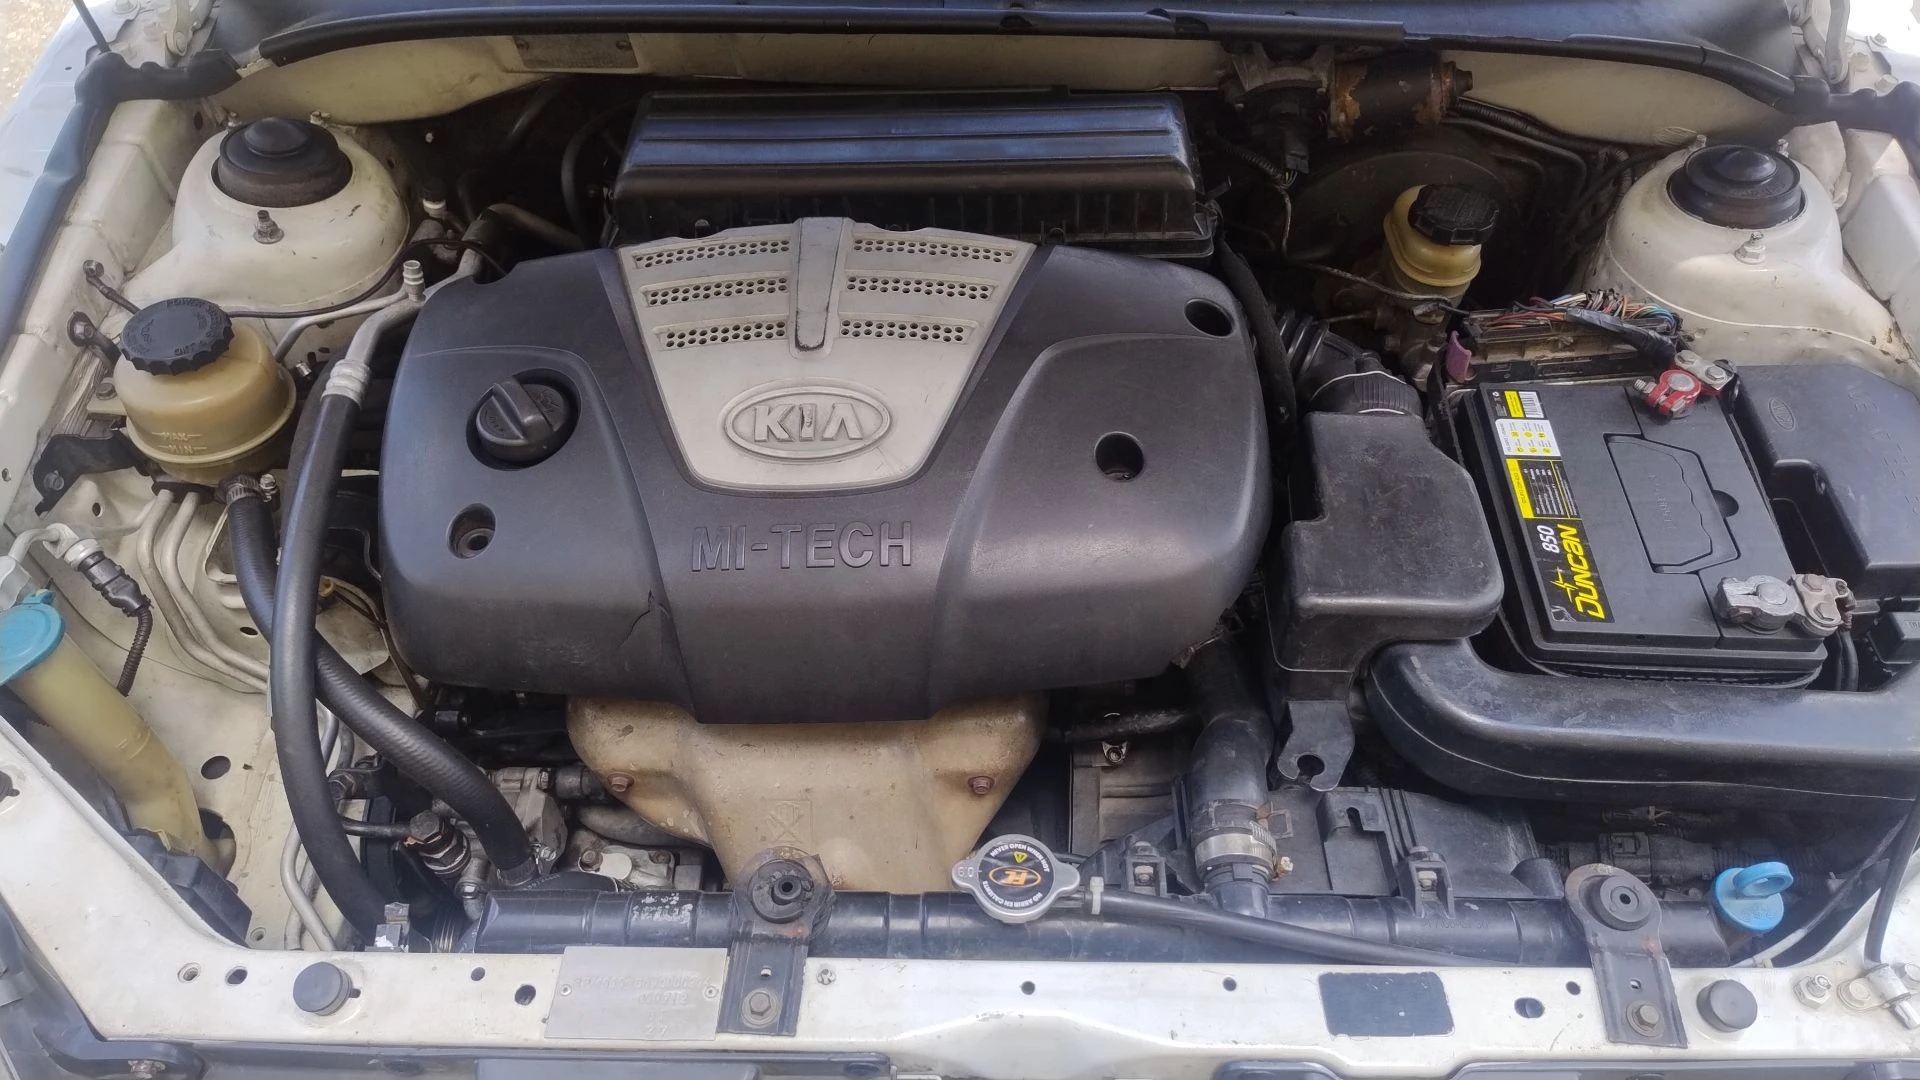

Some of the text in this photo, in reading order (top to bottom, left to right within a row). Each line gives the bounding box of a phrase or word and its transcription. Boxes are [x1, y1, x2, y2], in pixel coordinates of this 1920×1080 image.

[753, 402, 864, 443] KIA
[691, 521, 912, 573] MI-TECH
[1537, 525, 1560, 554] 850
[990, 843, 1050, 872] NEVER OPEN WHEN HOT
[1004, 900, 1014, 908] EN
[1033, 892, 1043, 902] NO
